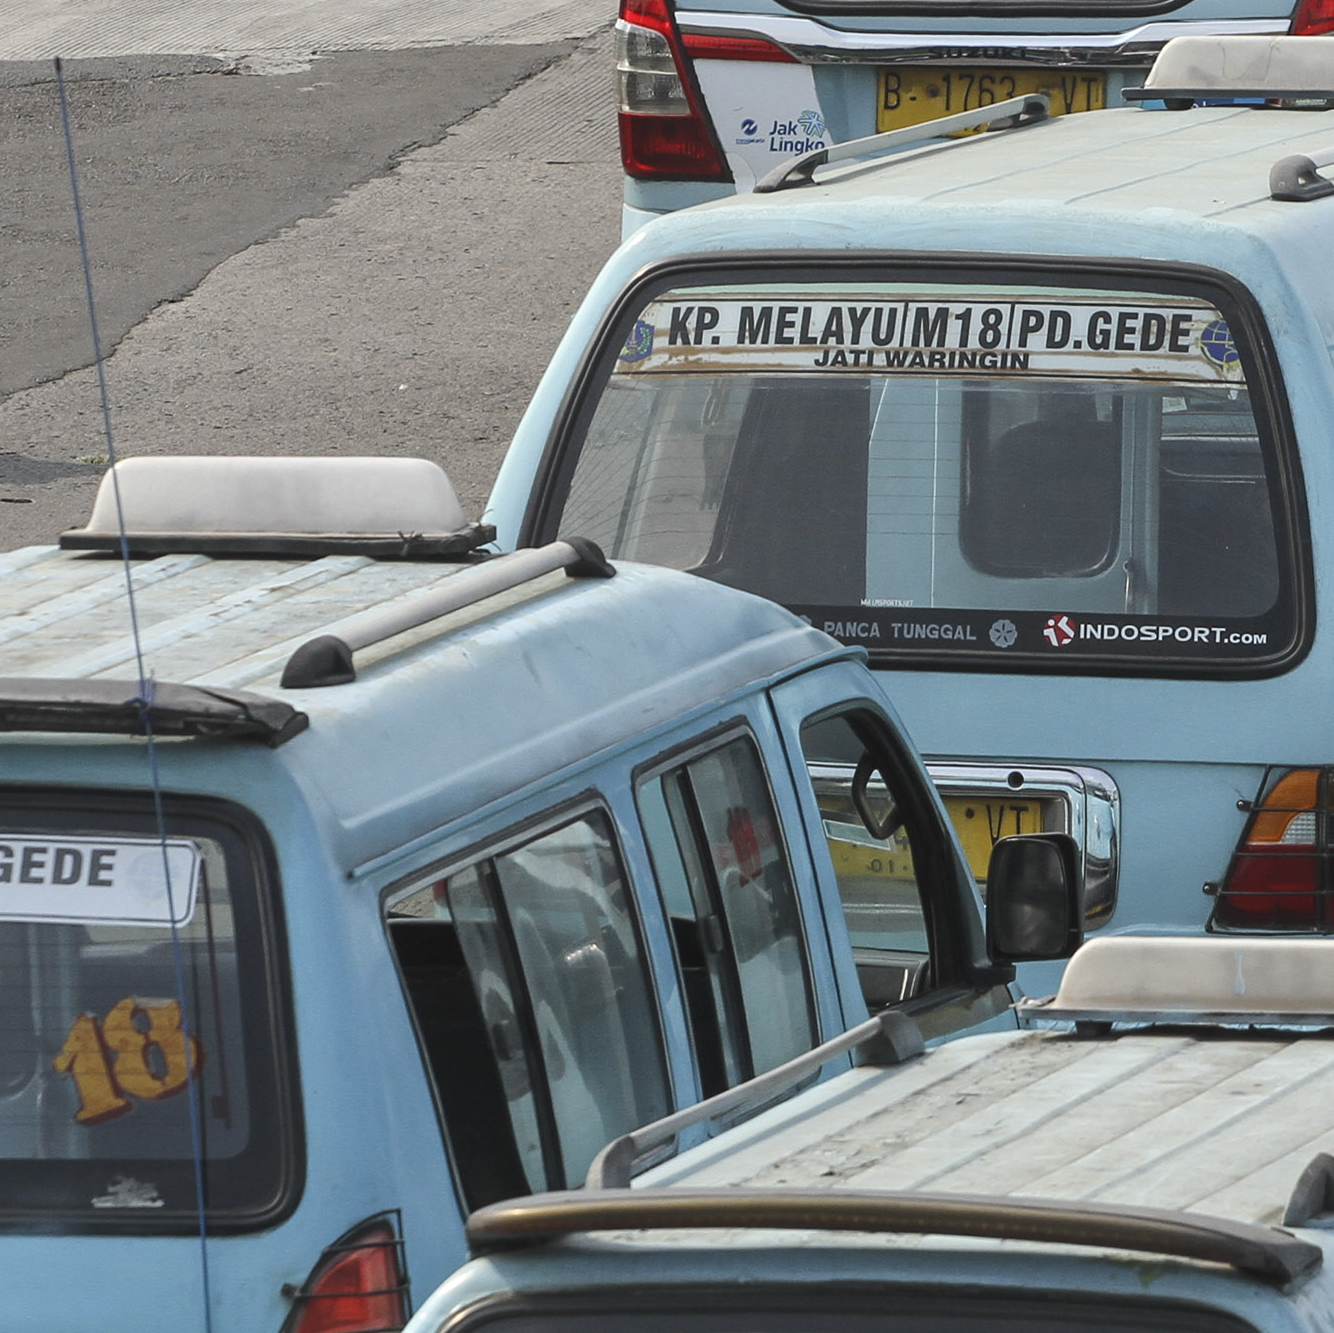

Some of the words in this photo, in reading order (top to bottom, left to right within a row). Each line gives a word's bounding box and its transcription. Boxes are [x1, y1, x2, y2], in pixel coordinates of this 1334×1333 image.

[884, 73, 900, 110] B
[942, 73, 1015, 112] 1763
[1062, 73, 1097, 113] VT
[769, 120, 799, 135] Jak
[770, 136, 825, 156] Lingko
[668, 307, 721, 346] KP.
[737, 306, 903, 348] MELAYU
[912, 307, 1003, 350] M18
[1018, 309, 1193, 353] PD.GEDE
[814, 349, 879, 368] JATI
[884, 349, 1029, 371] WARINGIN
[823, 620, 881, 639] PANCA
[891, 622, 976, 641] TUNGGAL
[53, 996, 205, 1126] 18
